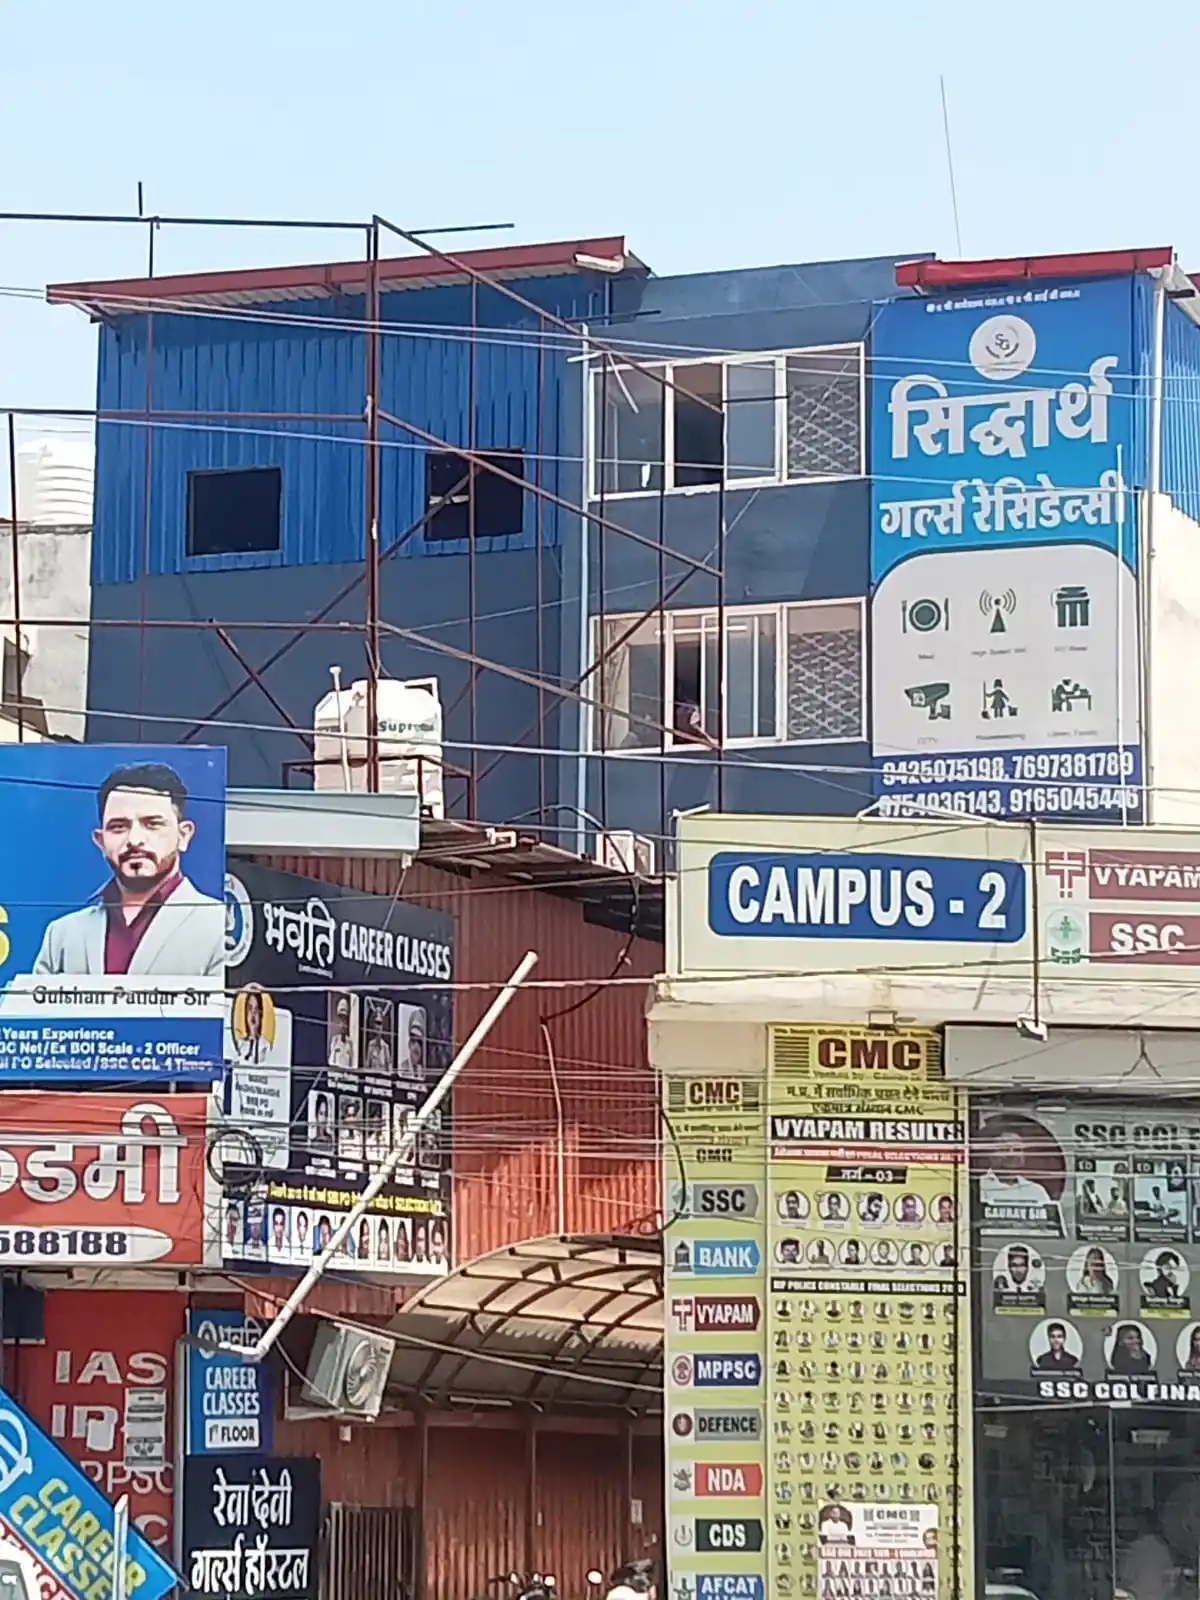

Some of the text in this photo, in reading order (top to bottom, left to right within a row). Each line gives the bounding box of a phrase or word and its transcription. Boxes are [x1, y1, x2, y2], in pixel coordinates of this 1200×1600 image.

[887, 355, 1119, 459] सिद्धार्थ
[880, 479, 969, 539] गर्ल्स
[1012, 752, 1134, 778] 7697381789
[1093, 864, 1200, 889] VYAPAM
[727, 865, 934, 928] CAMPUS
[977, 870, 1007, 929] 2
[263, 897, 452, 980] भवति CAREER CLASSES
[1110, 923, 1185, 954] SSC
[184, 987, 211, 1006] Sir
[2, 1028, 115, 1042] Years Experience
[70, 1043, 95, 1055] BOI
[98, 1042, 133, 1055] Scale
[144, 1043, 153, 1055] 2
[156, 1042, 201, 1056] Officer
[818, 1037, 921, 1070] CMC
[689, 1082, 740, 1104] CMC
[774, 1119, 864, 1140] VYAPAM
[870, 1121, 962, 1141] RESULTS
[701, 1189, 746, 1213] SSC
[699, 1246, 752, 1268] BANK
[697, 1304, 753, 1325] VYAPAM
[54, 1350, 168, 1384] IAS
[205, 1366, 257, 1390] CAREER
[698, 1361, 757, 1379] MPPSC
[1039, 1381, 1089, 1398] SSC
[1095, 1382, 1138, 1399] CGL
[203, 1392, 260, 1416] CLASSES
[221, 1426, 256, 1442] FLOOR
[699, 1416, 757, 1433] DEFENCE
[707, 1469, 746, 1492] NDA
[709, 1524, 746, 1547] CDS
[191, 1532, 310, 1596] गर्ल्स हॉस्टल
[701, 1577, 757, 1595] AFCAT
